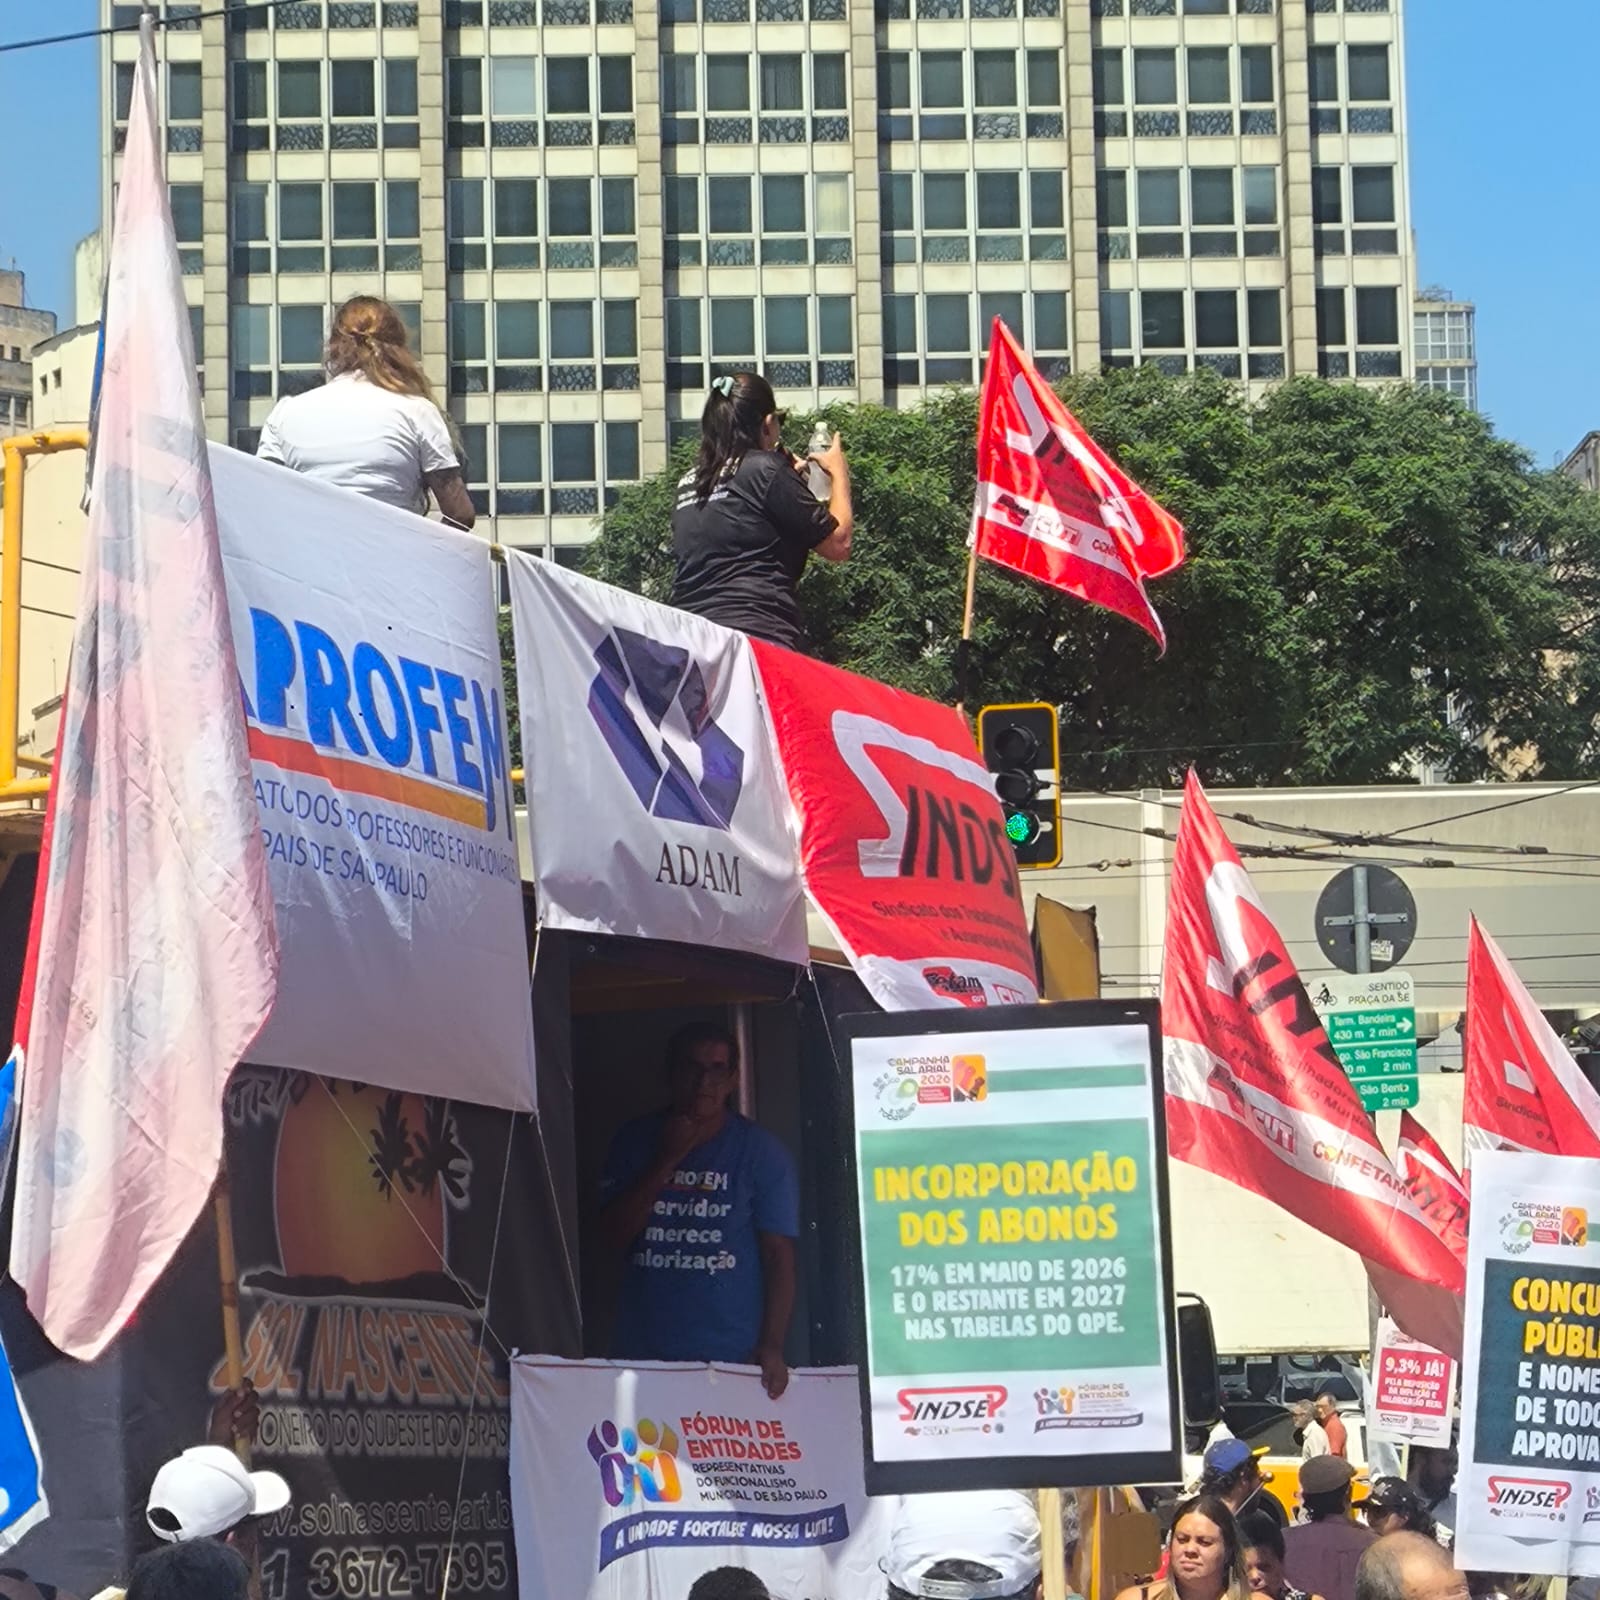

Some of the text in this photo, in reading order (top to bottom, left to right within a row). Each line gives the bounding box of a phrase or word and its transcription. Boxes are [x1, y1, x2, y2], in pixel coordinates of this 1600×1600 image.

[239, 606, 514, 842] PROFEM
[253, 778, 294, 814] ATO
[295, 789, 343, 828] DOS
[832, 709, 1015, 898] SINDS
[261, 829, 308, 867] PAIS
[374, 860, 429, 901] PAULO
[655, 841, 742, 896] ADAM
[1348, 994, 1379, 1006] PRAÇA
[1381, 993, 1396, 1003] DA
[1368, 980, 1409, 992] SENTIDO
[1334, 1013, 1396, 1027] Term. Bandeira
[1334, 1027, 1398, 1041] 430 m 2 min
[887, 1055, 951, 1067] CAMPANHA
[1339, 1047, 1413, 1064] go. São Francisco
[1355, 1064, 1367, 1073] m
[1383, 1062, 1391, 1072] 2
[1392, 1061, 1412, 1072] min
[896, 1065, 951, 1076] SALARIAL
[920, 1075, 951, 1085] 2026
[1360, 1082, 1409, 1095] São Bento
[1383, 1096, 1410, 1107] 2 min
[1252, 1108, 1296, 1154] CUT
[873, 1151, 1138, 1202] INCORPORAÇÃO
[652, 1198, 732, 1218] ervidor
[645, 1226, 723, 1243] merece
[899, 1203, 1119, 1247] DOS ABONOS
[633, 1248, 737, 1275] alorização
[891, 1257, 1127, 1286] 17% EM MAIO DE 2026
[892, 1284, 1127, 1314] E O RESTANTE EM 2027
[1512, 1276, 1600, 1316] CONCU
[905, 1312, 1126, 1341] NAS TABELAS DO QPE.
[1525, 1317, 1600, 1359] PÚBL
[1385, 1356, 1446, 1378] 9,3% JÁ!
[1518, 1361, 1600, 1395] E NOME
[1078, 1390, 1130, 1400] ENTIDADES
[1112, 1382, 1125, 1390] DE
[897, 1384, 1009, 1421] SINDSEP
[1515, 1395, 1600, 1428] DE TOD
[258, 1408, 508, 1449] ONEIRO DO SUDESTE DO BRAS
[680, 1412, 786, 1440] FÓRUM DE
[687, 1440, 802, 1461] ENTIDADES
[1512, 1429, 1600, 1462] APROVA
[692, 1461, 786, 1475] REPRESENTATIVAS
[696, 1476, 713, 1488] DO
[753, 1490, 770, 1502] DE
[770, 1489, 793, 1503] SÃO
[1487, 1475, 1572, 1508] SINDSEP
[264, 1492, 512, 1538] w.solnascente.art.b
[615, 1529, 625, 1550] A
[751, 1521, 800, 1540] NOSSA
[261, 1549, 290, 1600] 1
